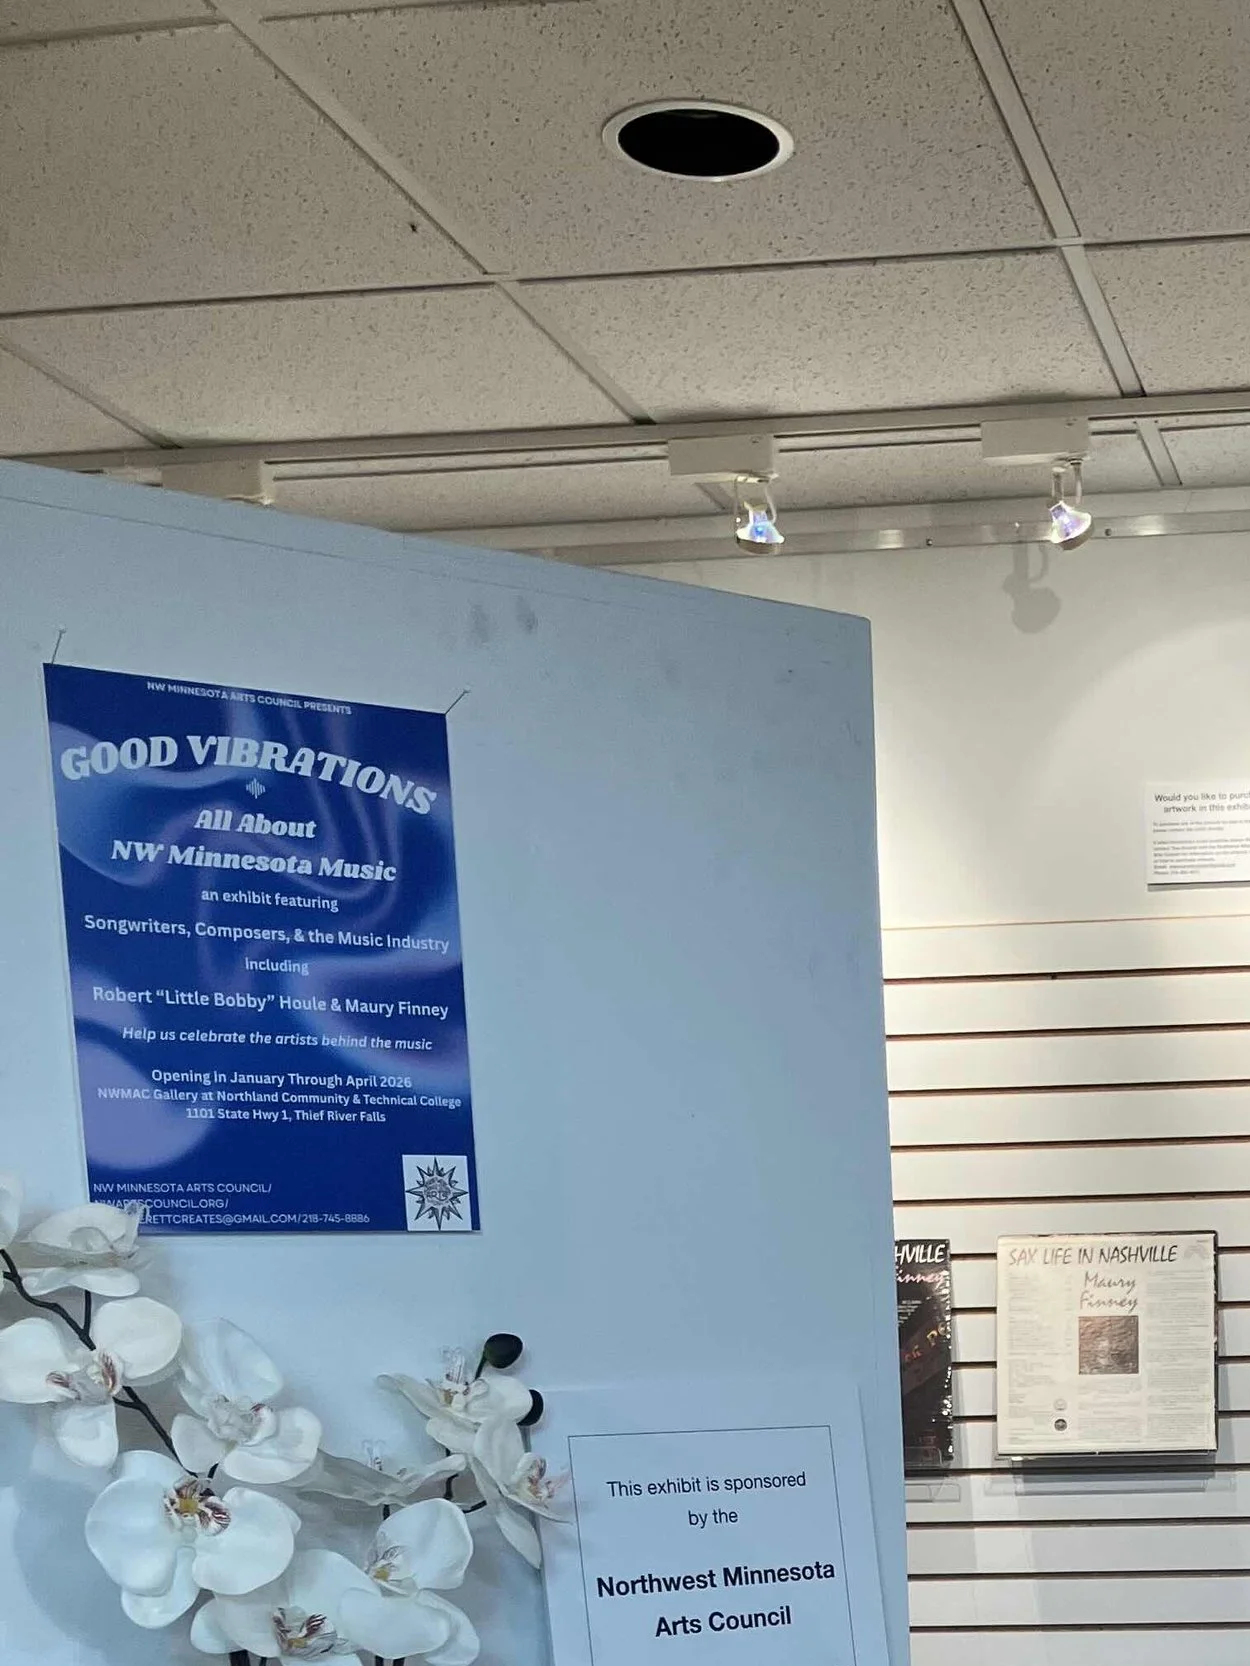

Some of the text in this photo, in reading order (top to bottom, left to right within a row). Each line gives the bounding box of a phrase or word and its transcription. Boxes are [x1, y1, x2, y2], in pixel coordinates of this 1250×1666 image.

[147, 682, 352, 715] NW MINNESOTA ARTS COUNCIL PRESENTS
[60, 735, 437, 815] GOOD VIBRATIONS
[1154, 793, 1181, 803] Would
[1183, 795, 1199, 803] you
[1200, 792, 1216, 801] like
[1163, 804, 1197, 814] artwork
[1198, 804, 1208, 812] in
[1209, 803, 1225, 812] this
[193, 809, 318, 839] All About
[111, 839, 398, 882] NW Minnesota Music
[201, 890, 340, 913] an exhibit featuring
[84, 914, 450, 955] Songwriters, Composers, & the Music Industry
[92, 986, 153, 1004] Robert
[279, 995, 327, 1012] Houle
[330, 998, 342, 1013] &
[345, 999, 394, 1018] Maury
[398, 1001, 449, 1021] Finney
[122, 1027, 433, 1051] Help us celebrate the artists behind the music
[151, 1069, 212, 1086] Opening
[230, 1071, 285, 1089] January
[287, 1073, 343, 1089] Through
[345, 1075, 378, 1090] April
[380, 1076, 412, 1089] 2026
[97, 1087, 462, 1110] NWMAC Gallery at Northland Community & Technical College
[186, 1107, 387, 1123] 1101 State Hwy 1, Thief River Falls
[93, 1183, 272, 1194] NW MINNESOTA ARTS COUNCIL/
[1009, 1244, 1179, 1266] SAX LIFE IN NASHVILLE
[1084, 1271, 1137, 1295] Maury
[1080, 1290, 1138, 1314] Finney
[606, 1471, 807, 1498] This exhibit is sponsored
[688, 1508, 739, 1530] by the
[596, 1561, 836, 1599] Northwest Minnesota
[654, 1605, 792, 1638] Arts Council
